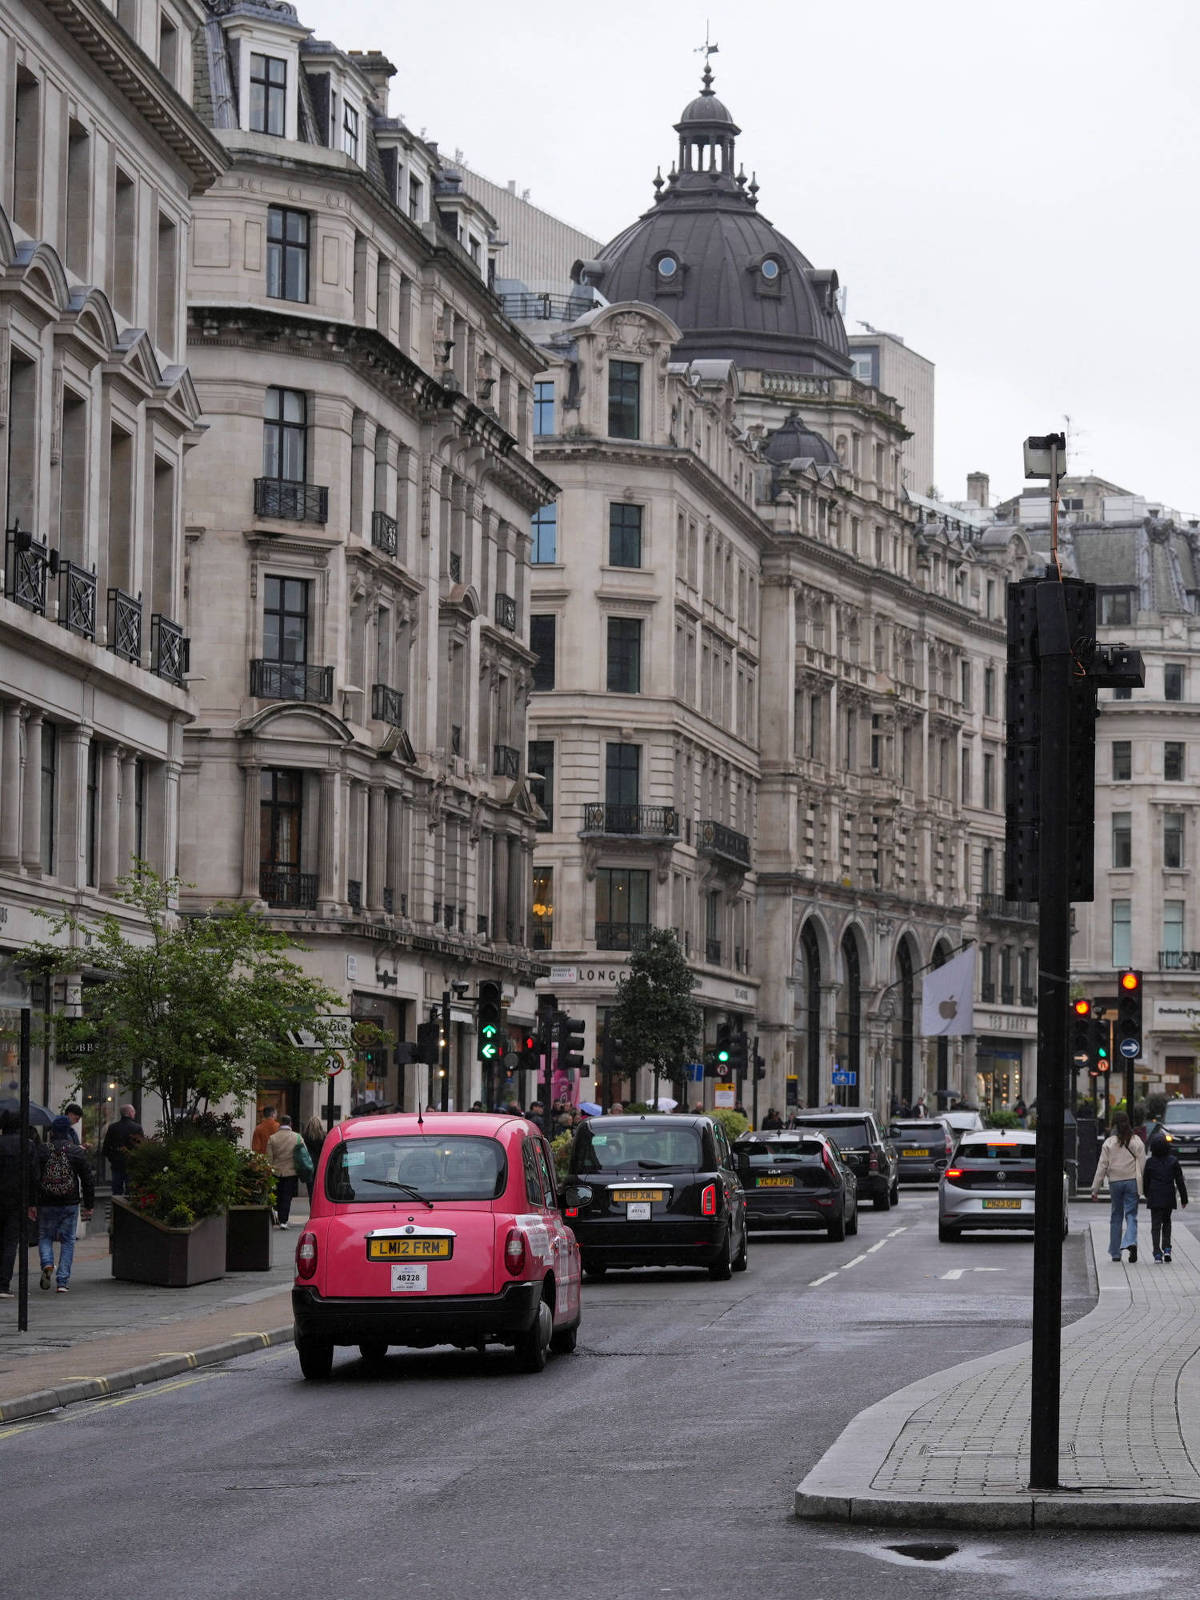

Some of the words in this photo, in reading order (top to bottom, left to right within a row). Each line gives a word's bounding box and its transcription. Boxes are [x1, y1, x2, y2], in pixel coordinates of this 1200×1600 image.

[325, 1058, 341, 1069] 20
[379, 1241, 410, 1255] LM12
[413, 1241, 440, 1254] FRM
